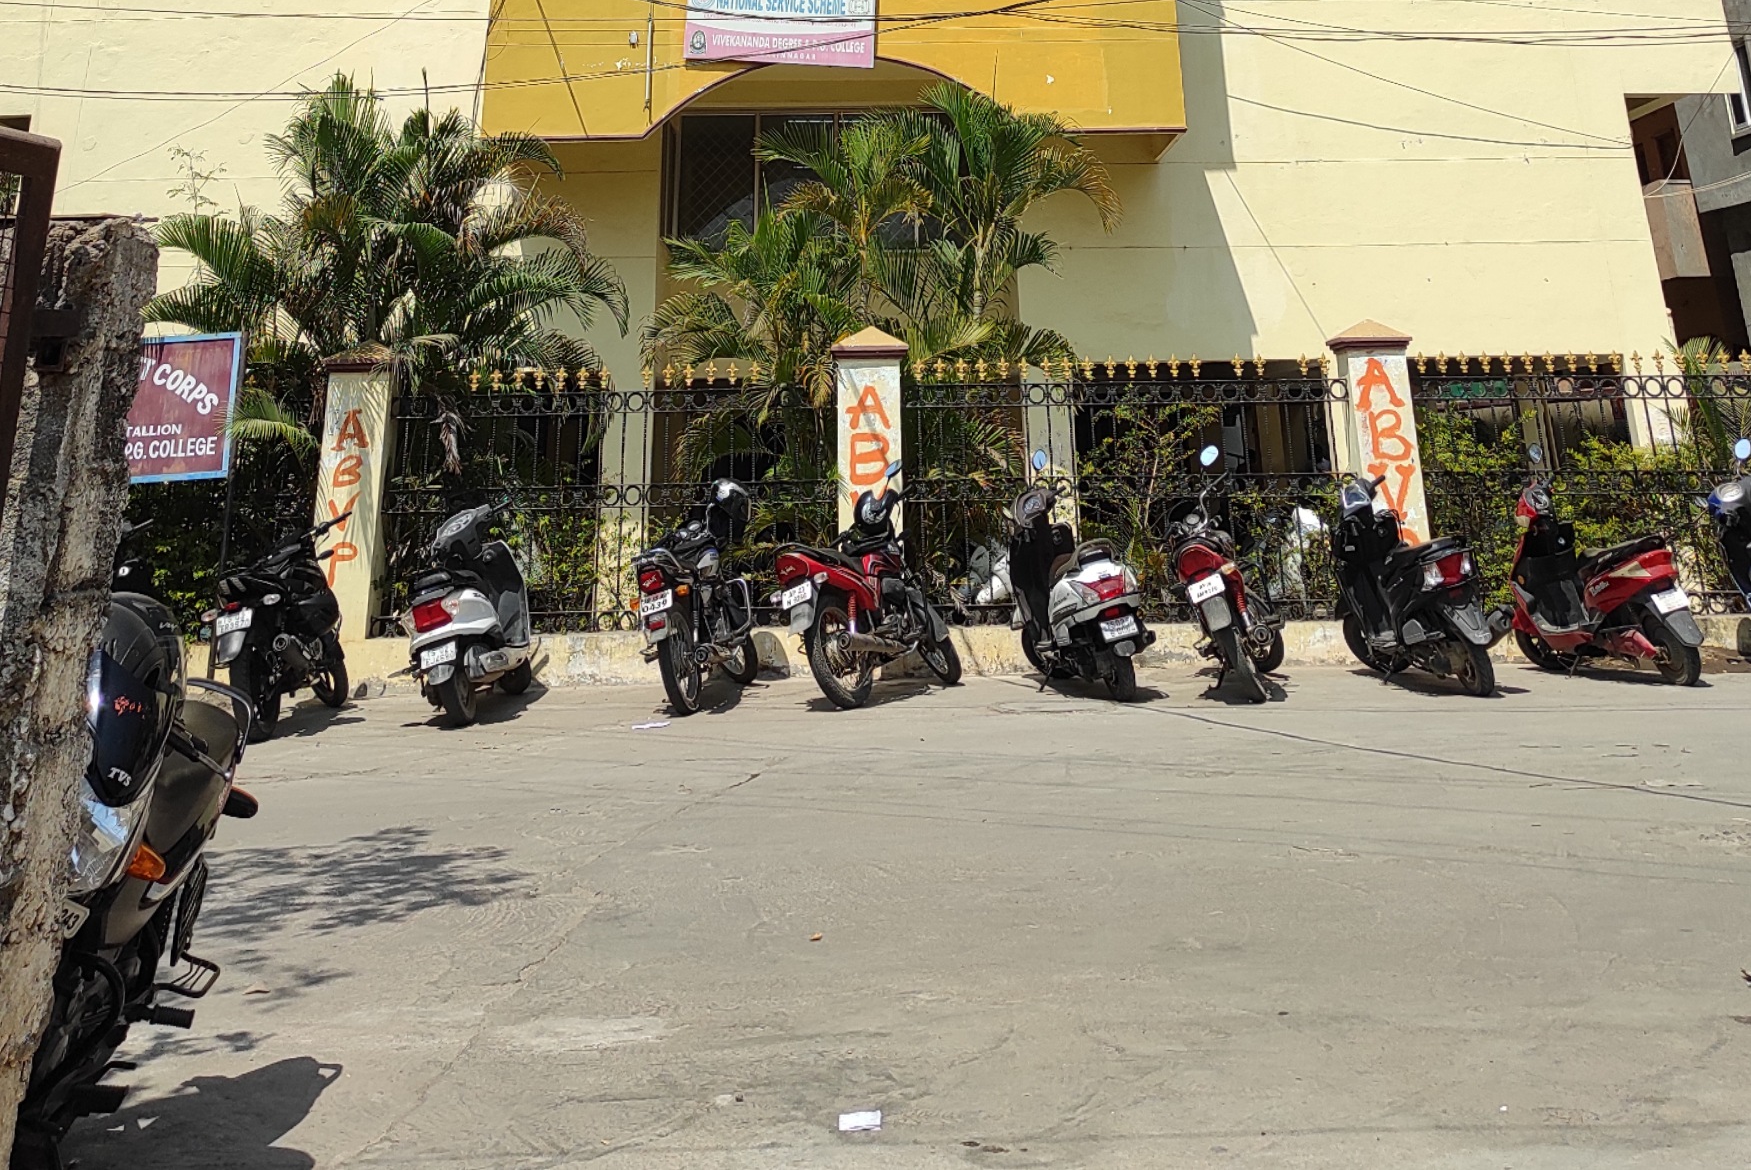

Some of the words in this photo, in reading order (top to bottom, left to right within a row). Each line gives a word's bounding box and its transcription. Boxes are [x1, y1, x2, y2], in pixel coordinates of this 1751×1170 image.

[712, 34, 770, 49] VIVEKANANDA
[831, 41, 866, 54] COLLEGE
[152, 363, 219, 415] CORPS
[125, 423, 183, 438] TALLION
[149, 436, 218, 459] COLLEGE
[845, 383, 891, 508] AB
[108, 767, 132, 787] TVS
